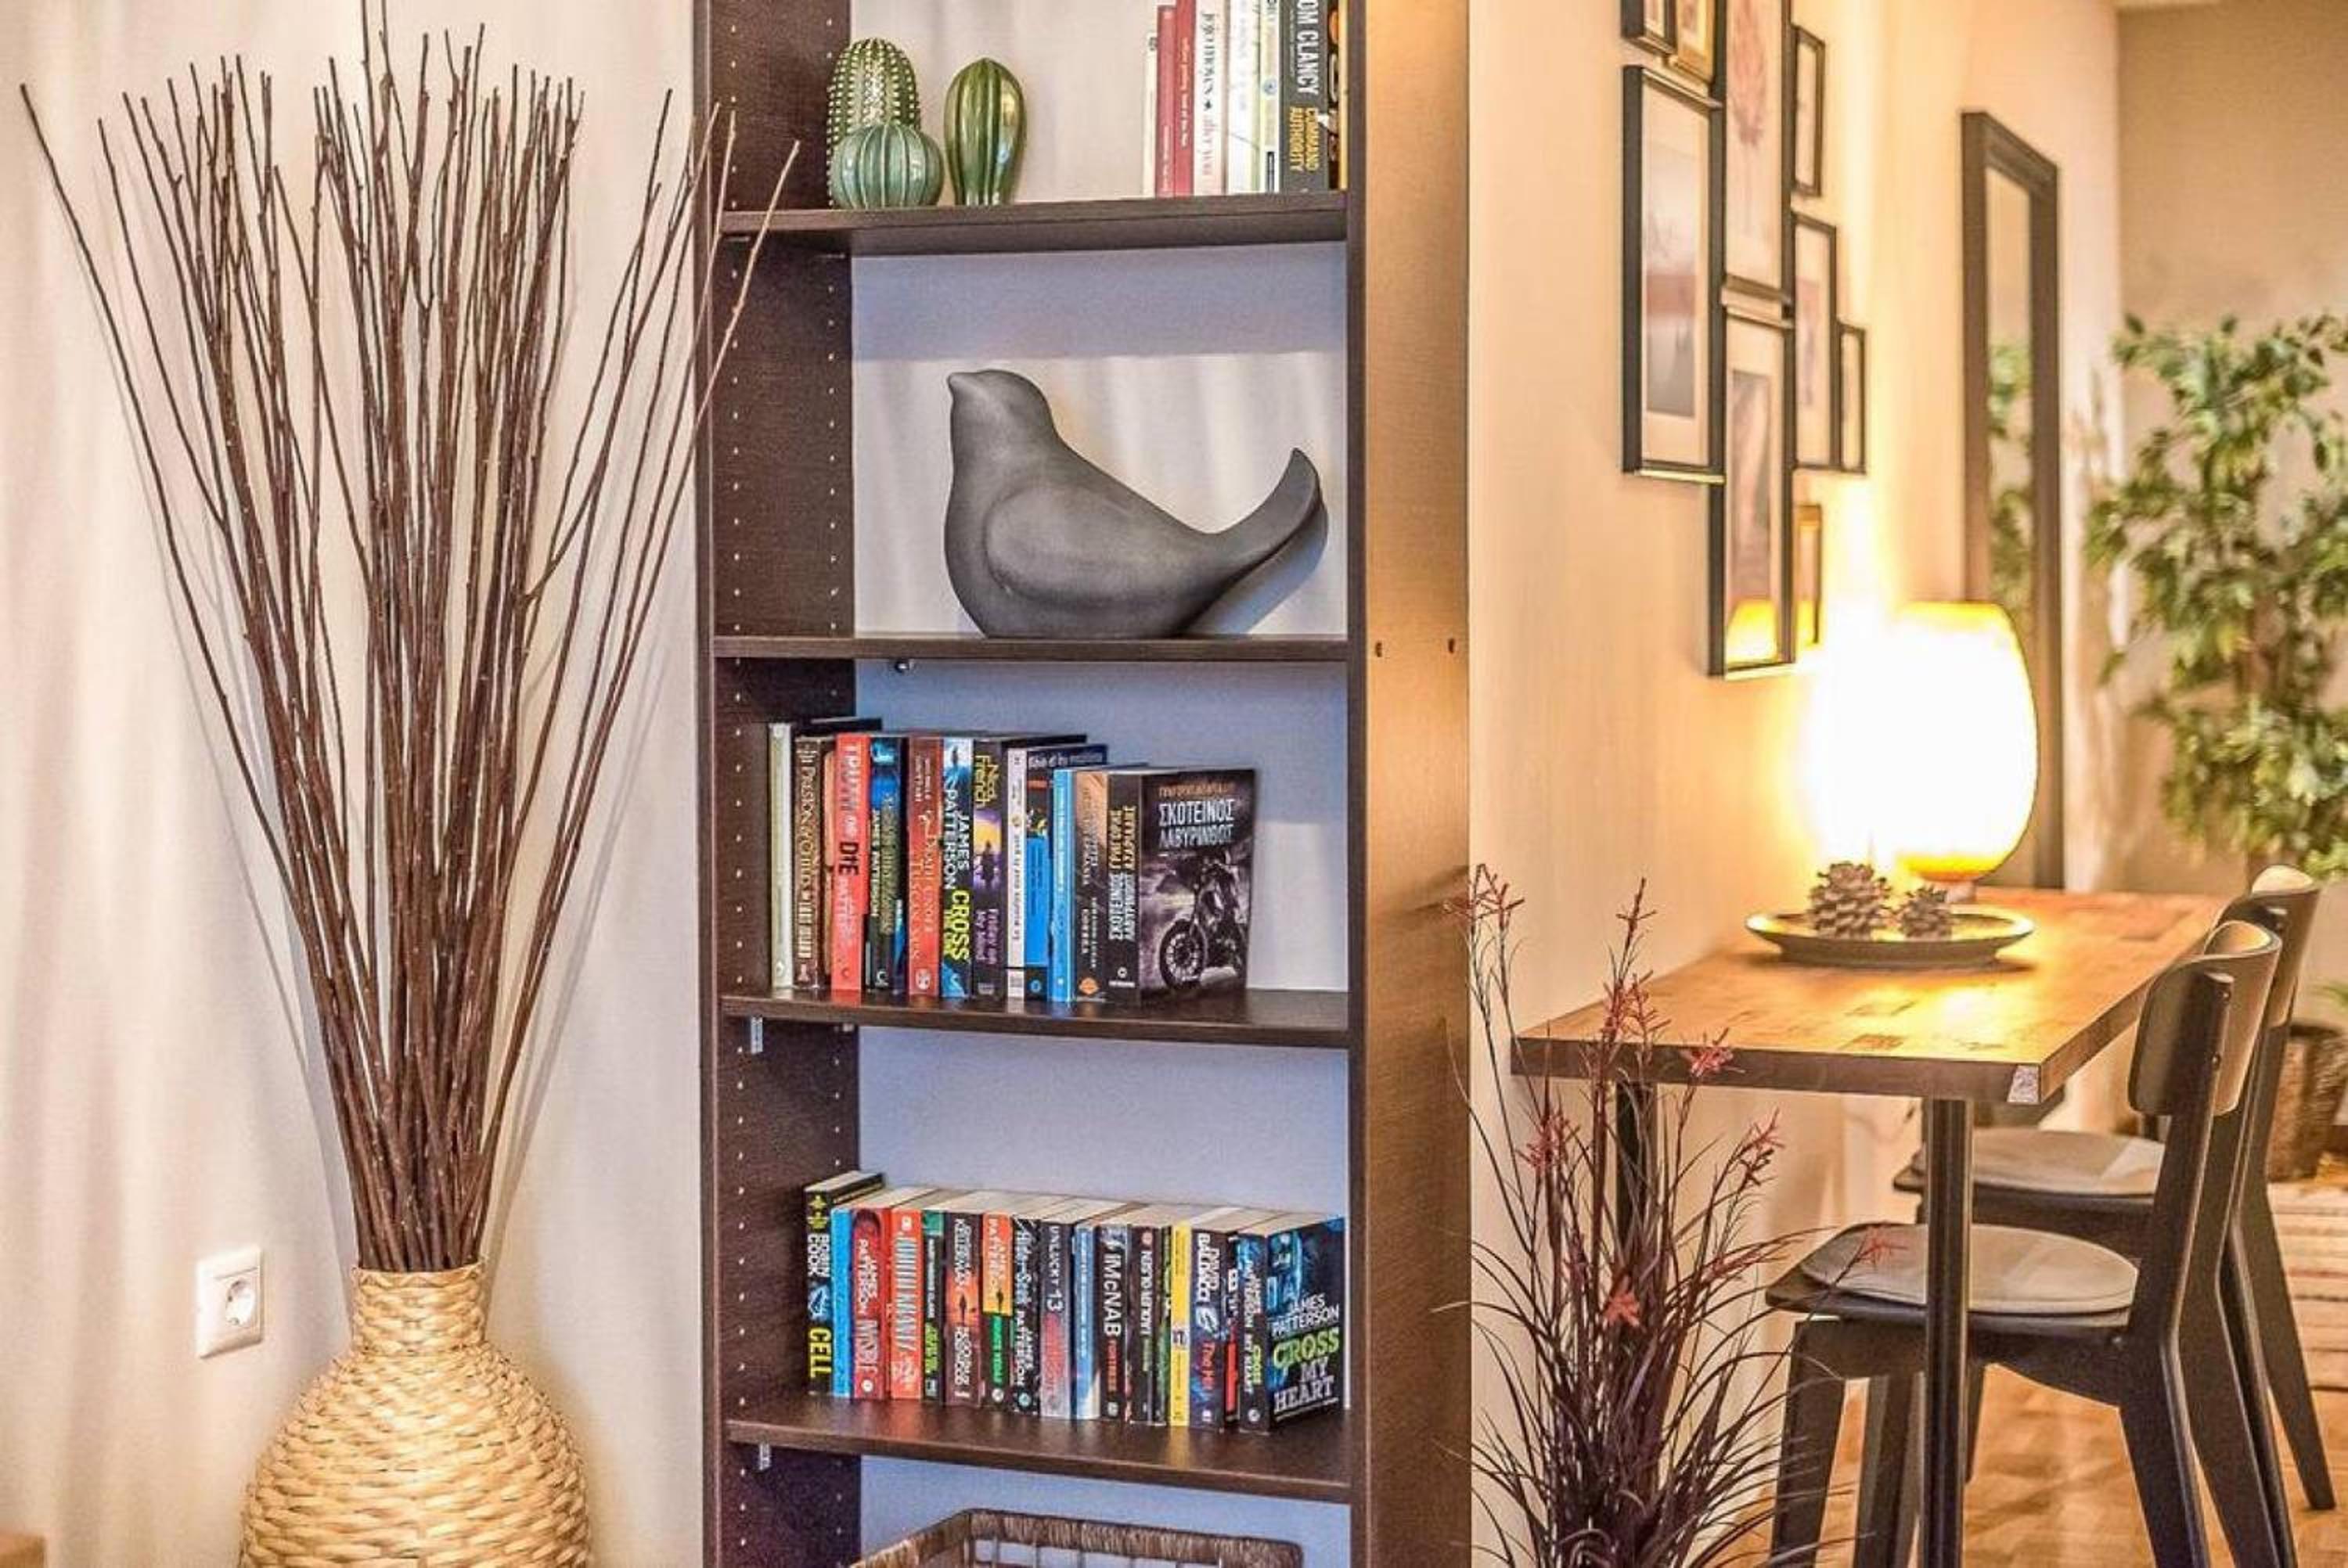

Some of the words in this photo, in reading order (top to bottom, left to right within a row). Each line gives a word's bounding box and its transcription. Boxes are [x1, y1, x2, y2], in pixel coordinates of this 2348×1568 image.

[1296, 0, 1319, 24] OM
[1297, 30, 1319, 95] CLANCY
[1290, 106, 1305, 172] AUTHORITY
[1305, 106, 1320, 171] COMMAND
[974, 754, 990, 807] French
[1158, 799, 1235, 826] ΣΚΟΤΕΙΝΟΣ
[944, 789, 956, 890] PATTERSON
[957, 811, 970, 871] JAMES
[871, 850, 880, 918] PATTERSON
[951, 890, 970, 960] CROSS
[807, 1233, 819, 1278] COOK
[819, 1232, 830, 1278] ROBIN
[858, 1239, 869, 1314] PATTERSON
[868, 1259, 877, 1299] JAMES
[1050, 1225, 1060, 1286] UNLUCKY
[1047, 1289, 1063, 1311] 13
[1271, 1302, 1340, 1340] PATTERSON
[809, 1328, 832, 1379] CELL
[1015, 1310, 1026, 1386] PATTERSON
[1025, 1329, 1034, 1370] JAMES
[1201, 1341, 1216, 1368] The
[1273, 1326, 1340, 1369] CROSS
[1273, 1375, 1334, 1415] HEART
